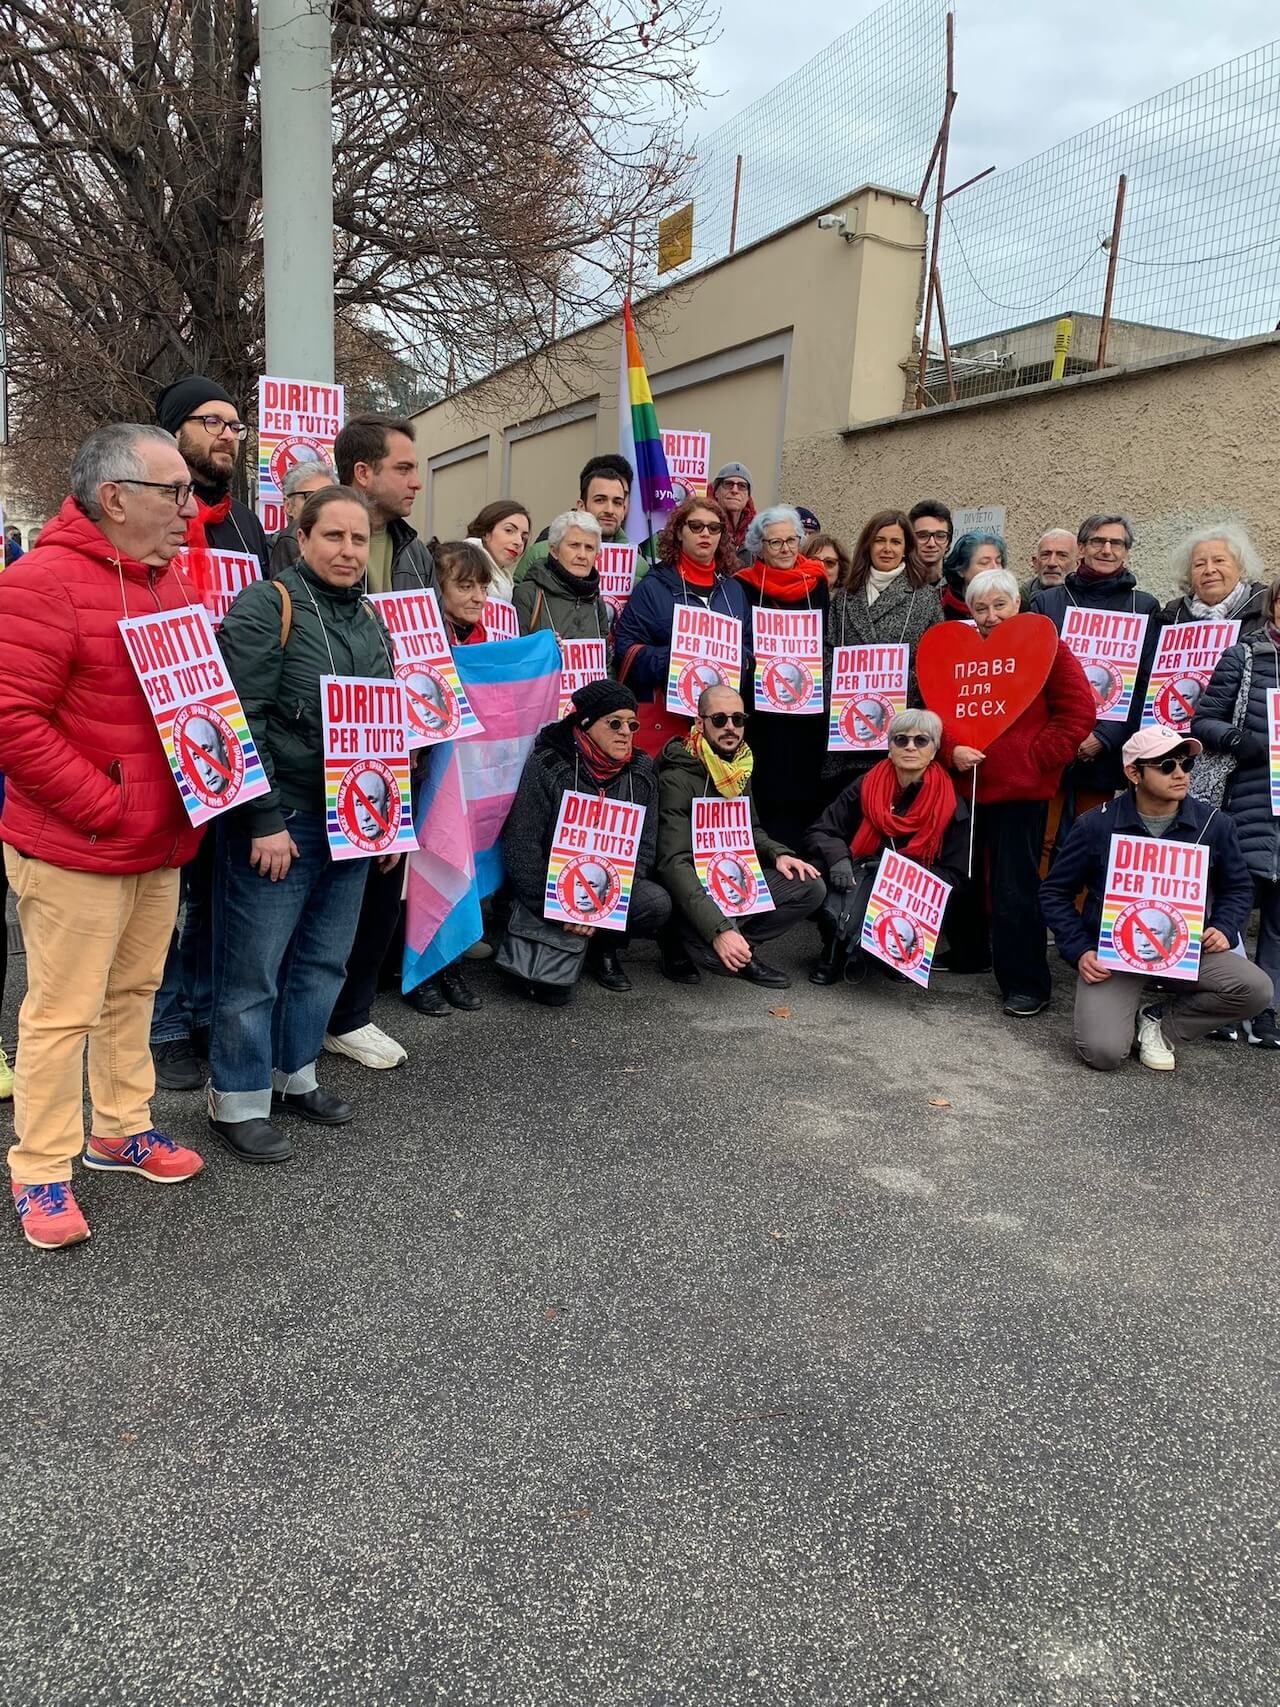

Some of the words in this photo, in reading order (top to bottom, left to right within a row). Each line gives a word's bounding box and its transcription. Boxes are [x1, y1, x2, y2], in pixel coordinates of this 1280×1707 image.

[264, 382, 339, 416] DIRITTI
[264, 414, 292, 431] PER
[297, 415, 339, 436] TUTT3
[672, 459, 705, 475] TUTT3
[600, 576, 631, 592] TUTT3
[375, 595, 438, 633] RITTI
[677, 609, 738, 646] DIRITTI
[756, 611, 817, 637] DIRITTI
[1067, 611, 1142, 642] DIRITTI
[126, 613, 213, 674] DIRITTI
[401, 632, 444, 658] TUTT3
[676, 635, 700, 655] PER
[705, 641, 738, 662] TUTT3
[756, 637, 777, 653] PER
[781, 639, 818, 654] TUTT3
[1094, 640, 1137, 659] TUTT3
[1161, 624, 1234, 652] DIRITTI
[563, 644, 604, 670] IRITTI
[837, 648, 904, 673] DIRITTI
[1156, 654, 1180, 669] PER
[1186, 651, 1222, 668] TUTT
[144, 674, 175, 707] PER
[173, 660, 224, 698] TUTT3
[561, 673, 576, 690] ER
[836, 675, 859, 690] PER
[865, 673, 903, 689] TUTT3
[327, 683, 404, 725] DIRITTI
[329, 728, 359, 753] PER
[364, 728, 404, 753] TUTT3
[563, 796, 640, 837] DIRITTI
[696, 801, 747, 829] DIRITTI
[558, 826, 586, 848] PER
[592, 832, 635, 857] TUTT3
[696, 831, 716, 849] PER
[719, 830, 750, 849] TUTT3
[1114, 840, 1202, 879] DIRITTI
[882, 854, 946, 908] DIRITTI
[1111, 872, 1144, 893] PER
[1151, 876, 1200, 900] TUTT3
[878, 879, 903, 902] PER
[905, 893, 939, 926] TUTT3
[120, 1142, 152, 1166] N
